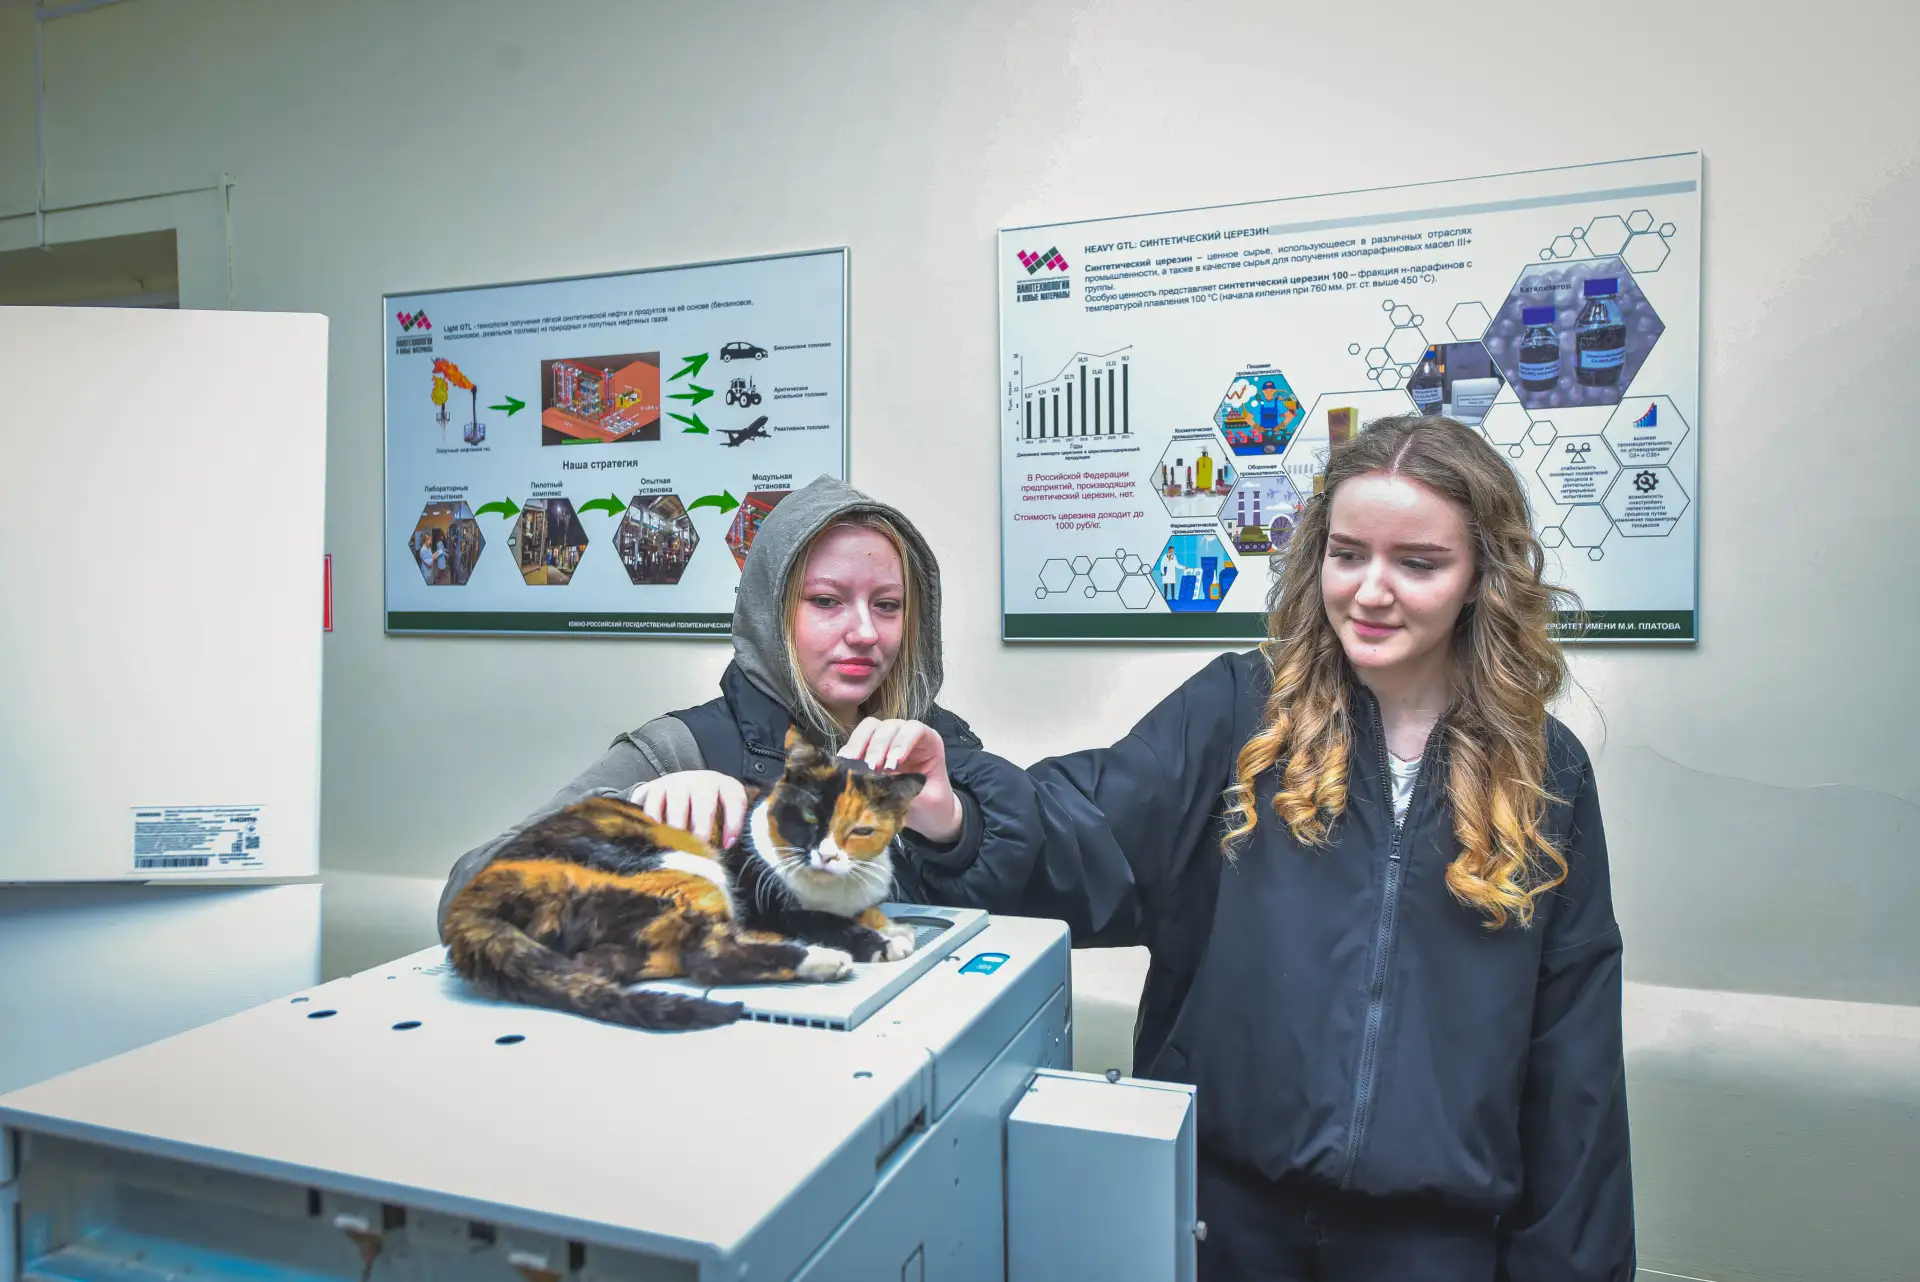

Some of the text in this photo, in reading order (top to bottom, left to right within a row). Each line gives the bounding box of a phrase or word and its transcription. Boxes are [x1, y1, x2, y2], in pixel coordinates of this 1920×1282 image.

[1085, 227, 1269, 253] HEAVY GTL: СИНТЕТИЧЕСКИЙ ЦЕРЕЗИН
[1085, 259, 1150, 272] Синтетический
[1156, 256, 1192, 266] церезин
[1208, 251, 1238, 261] ценное
[1243, 248, 1272, 257] сырье,
[1278, 239, 1355, 253] использующееся
[1372, 233, 1422, 245] различных
[1428, 228, 1472, 238] отраслях
[1085, 269, 1159, 283] промышленности,
[1169, 266, 1193, 274] также
[1203, 261, 1240, 270] качестве
[1243, 259, 1270, 268] сырья
[1272, 257, 1289, 265] для
[1291, 252, 1338, 264] получения
[1341, 244, 1422, 258] изопарафиновых
[1425, 241, 1454, 250] масел
[1085, 294, 1117, 303] Особую
[1119, 290, 1156, 300] ценность
[1159, 284, 1216, 296] представляет
[1219, 277, 1288, 290] синтетический
[1290, 274, 1329, 285] церезин
[1358, 267, 1398, 278] фракция
[1401, 261, 1464, 275] н-парафинов
[1085, 284, 1115, 293] группы.
[1520, 283, 1571, 293] Катализатор
[1085, 300, 1142, 313] температурой
[1144, 297, 1189, 307] плавления
[1192, 295, 1206, 303] 100
[1220, 290, 1253, 302] (начала
[1255, 288, 1290, 297] кипения
[1293, 286, 1308, 295] при
[1311, 284, 1326, 292] 760
[1347, 281, 1357, 290] рт.
[1373, 278, 1398, 287] выше
[1401, 276, 1417, 284] 450
[510, 318, 540, 328] получения
[608, 310, 627, 319] нефти
[635, 307, 666, 318] продуктов
[563, 459, 638, 470] Наша стратегия
[752, 474, 792, 482] Модульная
[1036, 472, 1080, 481] Российской
[1084, 471, 1129, 480] Федерации
[1022, 481, 1135, 492] предприятий, производящих
[1023, 492, 1079, 501] синтетический
[1077, 521, 1101, 530] руб/кг.
